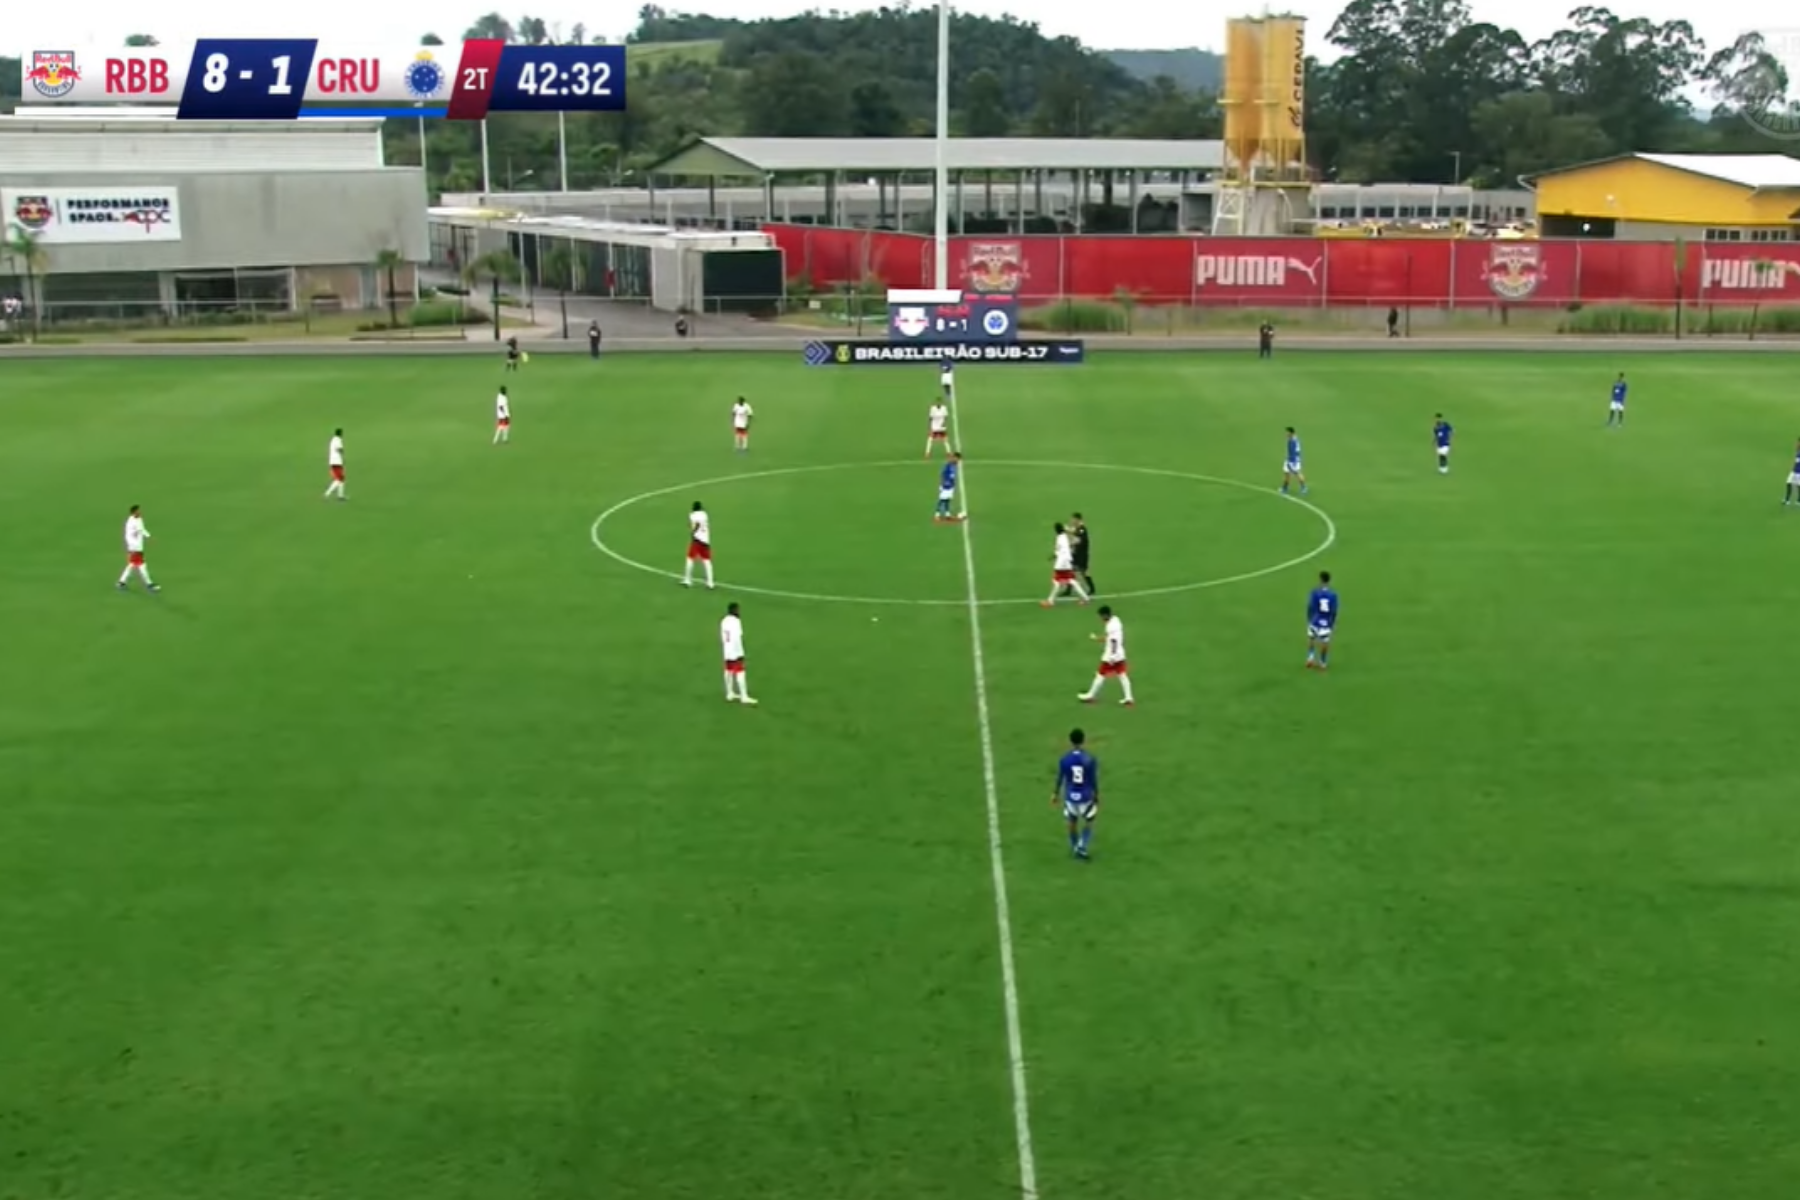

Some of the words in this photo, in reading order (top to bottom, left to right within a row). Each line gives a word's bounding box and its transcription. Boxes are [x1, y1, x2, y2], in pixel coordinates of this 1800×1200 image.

[1197, 256, 1285, 285] PUMA
[1702, 259, 1785, 288] PUMA
[854, 344, 982, 360] BRASILEIRÃO
[984, 347, 1049, 359] SUB-17
